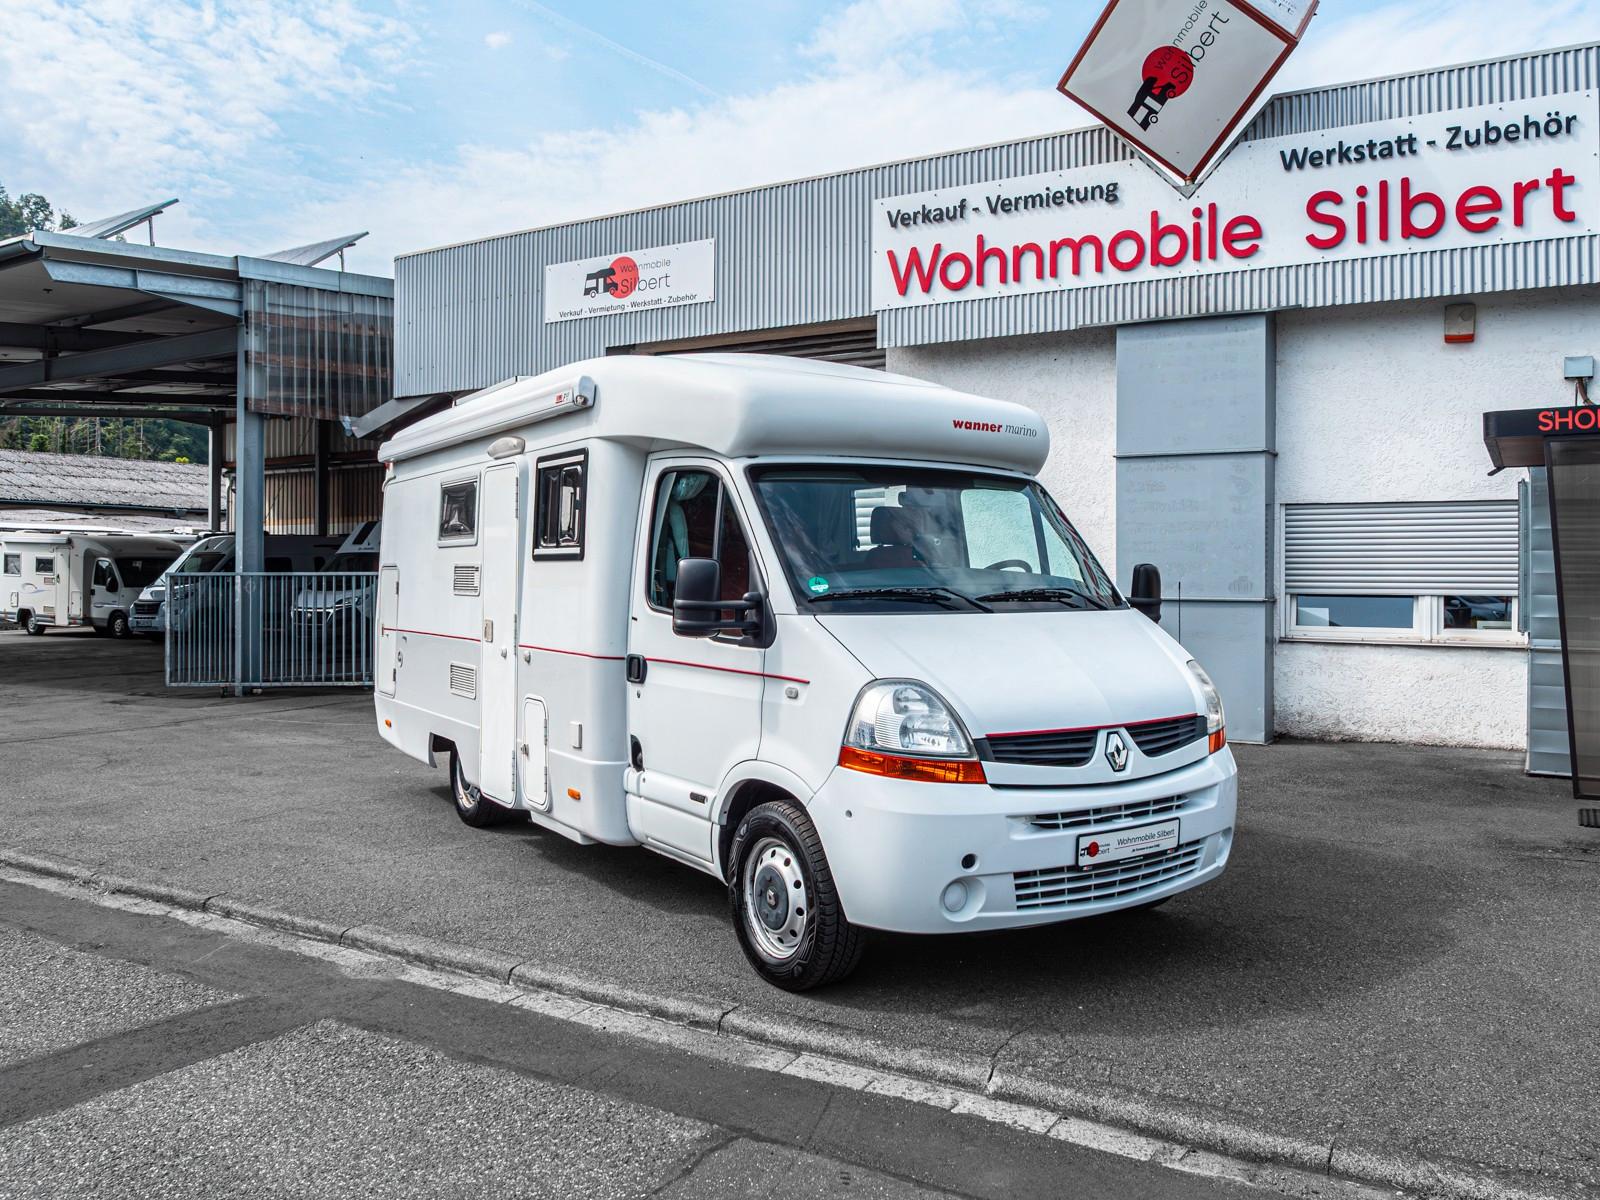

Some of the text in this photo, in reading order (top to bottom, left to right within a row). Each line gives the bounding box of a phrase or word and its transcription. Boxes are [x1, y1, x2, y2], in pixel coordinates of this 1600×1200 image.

[1171, 11, 1230, 84] Silbert
[1279, 133, 1417, 171] Werkstatt
[1446, 111, 1577, 150] Zubehör
[887, 198, 967, 229] Verkauf
[986, 182, 1119, 215] Vermietung
[887, 167, 1576, 297] Wohnmobile Silbert
[620, 273, 671, 294] Silbert
[559, 309, 583, 318] Verkauf
[588, 302, 626, 314] Vermietung
[630, 297, 662, 309] Werkstatt
[668, 293, 697, 304] Zubehör
[952, 419, 1038, 438] wanner marino
[1537, 408, 1600, 431] SHO
[1117, 828, 1175, 846] Wohnmobile Silbert
